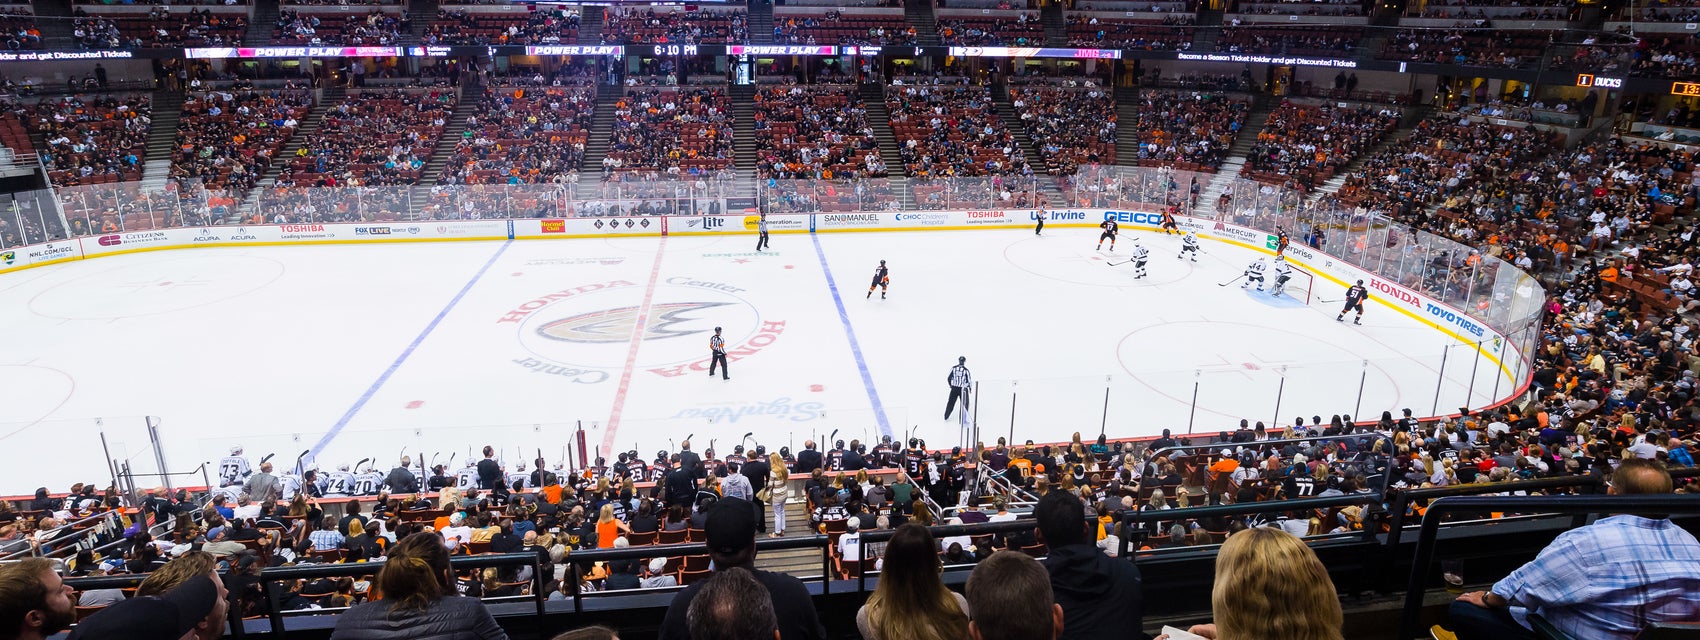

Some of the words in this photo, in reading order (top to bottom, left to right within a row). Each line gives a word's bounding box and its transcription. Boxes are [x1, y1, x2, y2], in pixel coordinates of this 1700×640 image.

[19, 52, 37, 60] and
[38, 52, 54, 60] get
[55, 51, 102, 59] Discounted
[255, 47, 306, 56] POWER
[309, 47, 343, 56] PLAY
[535, 46, 579, 55] POWER
[582, 46, 616, 55] PLAY
[654, 45, 679, 56] 6:10
[684, 45, 697, 55] PM
[743, 46, 786, 54] POWER
[788, 46, 819, 54] PLAY
[1297, 58, 1331, 66] Discounted
[1594, 76, 1622, 88] DUCKS
[1051, 210, 1086, 220] Irvine
[1104, 211, 1161, 225] GEICO
[280, 225, 325, 233] TOSHIBA
[703, 217, 724, 230] Lite
[369, 227, 391, 235] LIVE
[1226, 227, 1257, 240] MERCURY
[1250, 262, 1262, 270] 44
[496, 280, 636, 324] HONDA
[666, 276, 747, 293] Center
[1350, 291, 1359, 299] 51
[1369, 278, 1422, 309] HONDA
[1426, 303, 1455, 322] TOYO
[1455, 316, 1485, 338] TIRES
[645, 320, 786, 378] HONDA
[512, 357, 609, 384] Center
[222, 464, 240, 479] 73
[911, 461, 918, 473] 3
[460, 474, 468, 487] 6
[629, 468, 642, 482] 23
[329, 479, 345, 491] 74
[355, 480, 372, 493] 70
[1296, 482, 1314, 496] 77
